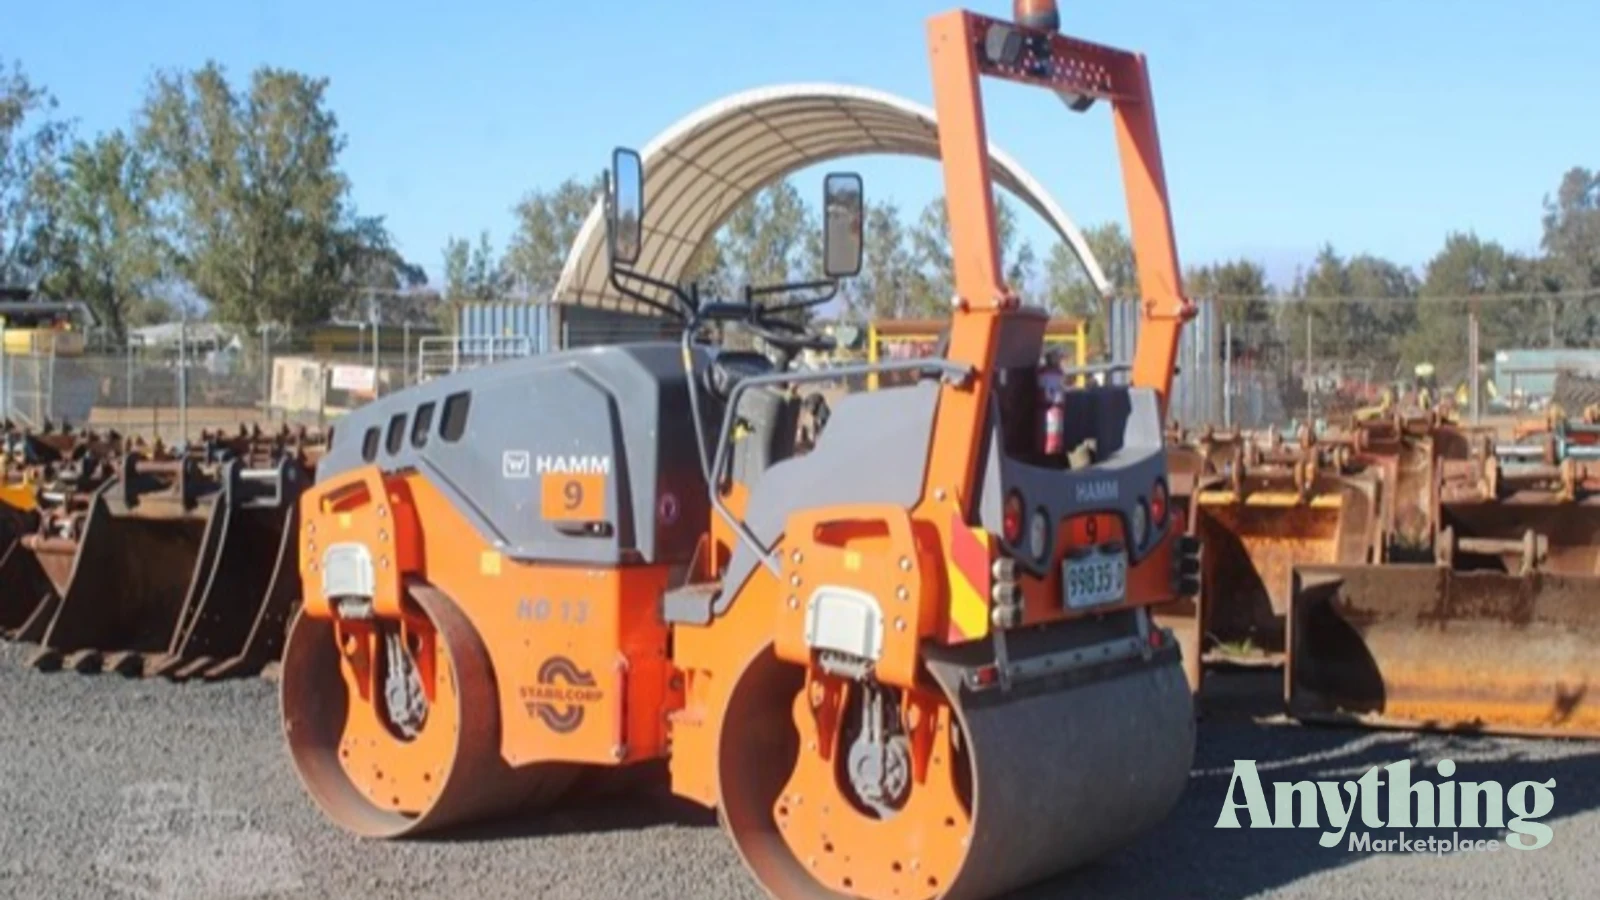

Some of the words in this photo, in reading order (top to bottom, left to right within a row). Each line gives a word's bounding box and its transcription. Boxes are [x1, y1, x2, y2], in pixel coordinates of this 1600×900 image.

[536, 456, 610, 475] HAMM
[563, 480, 584, 510] 9
[1075, 480, 1119, 502] HAMM
[1086, 516, 1098, 544] 9
[519, 686, 604, 702] STABILCORP
